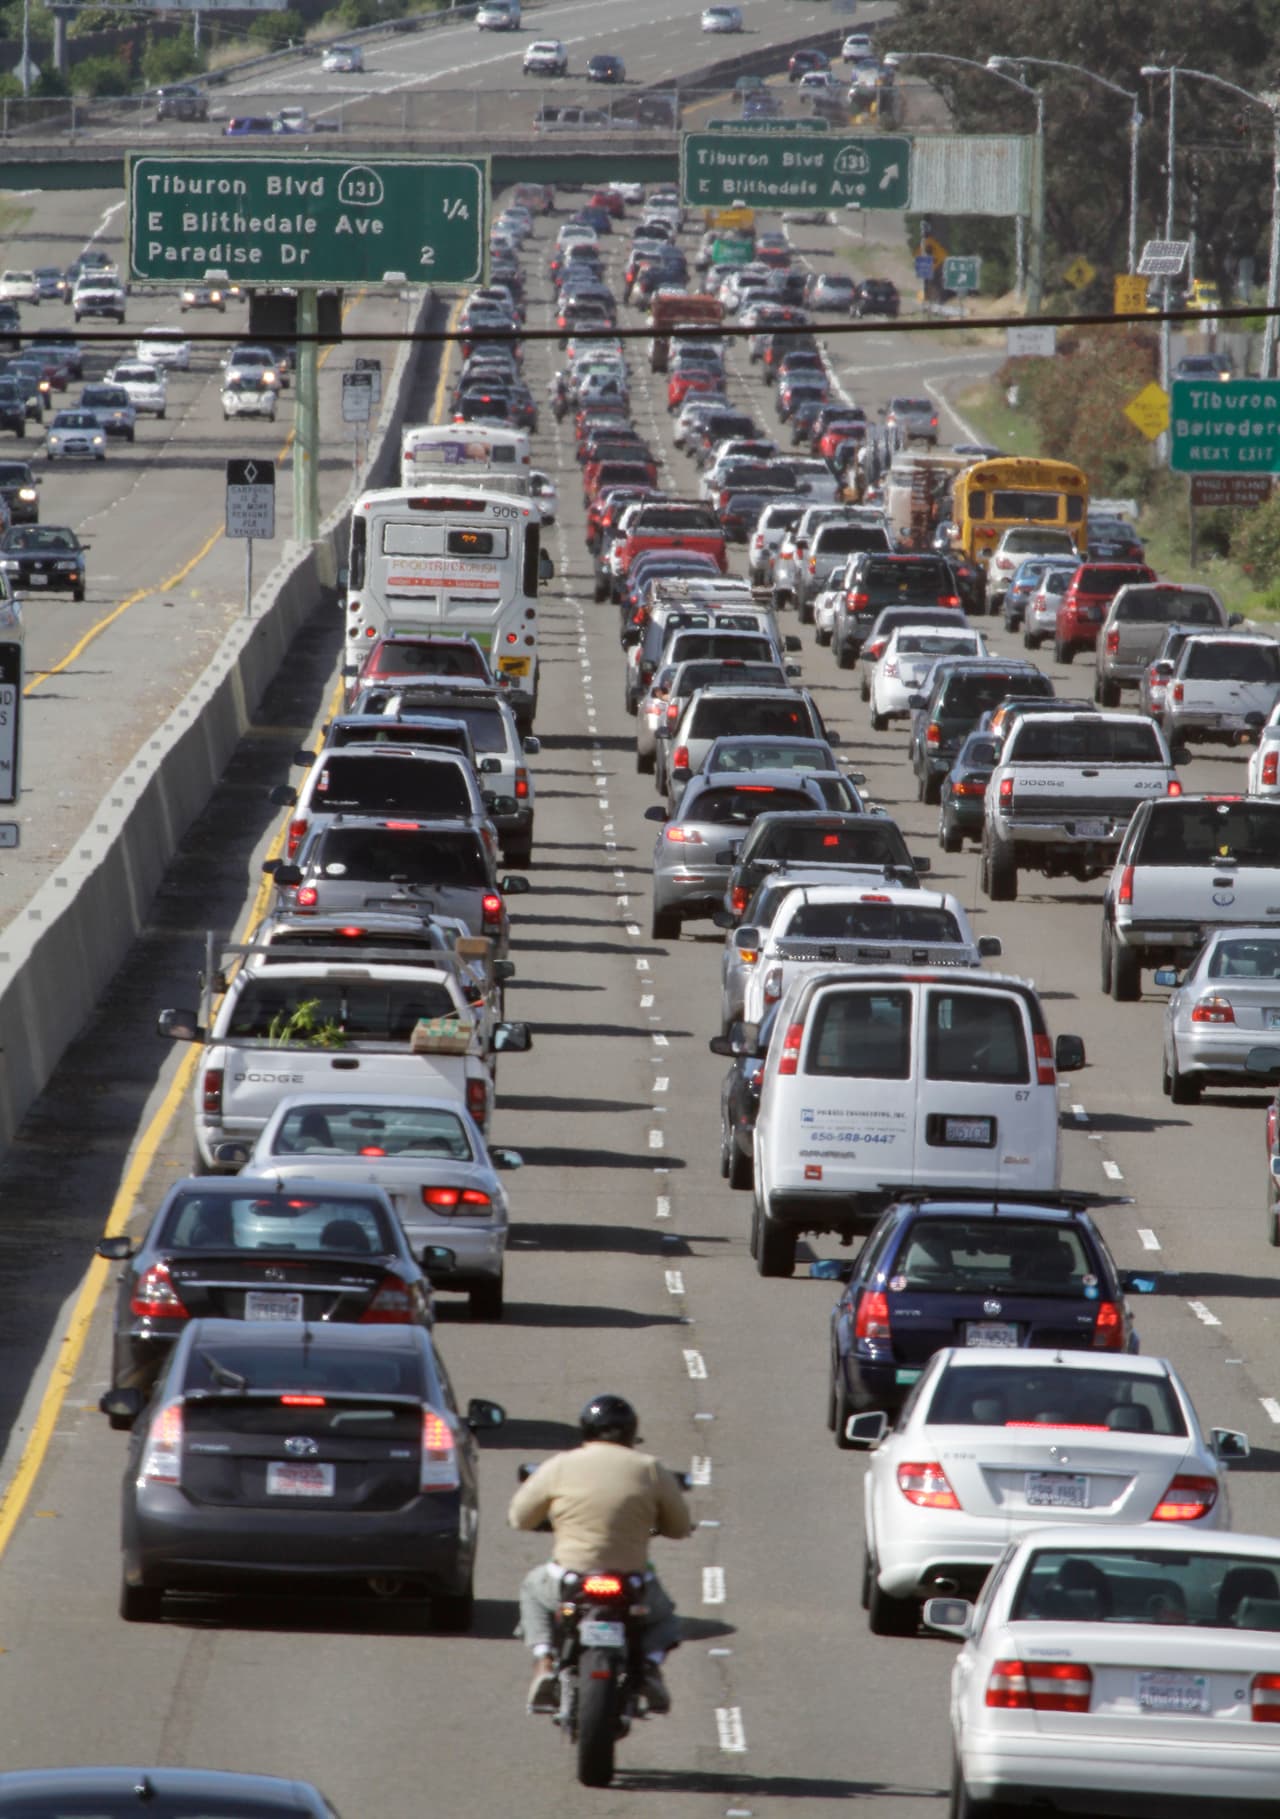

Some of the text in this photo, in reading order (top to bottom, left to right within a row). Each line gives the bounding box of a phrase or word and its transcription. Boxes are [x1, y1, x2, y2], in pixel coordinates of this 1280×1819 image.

[697, 150, 865, 170] Tiburon Blvd 131
[147, 175, 376, 197] Tiburon Blvd 131
[698, 179, 867, 196] E Blithedale Ave
[442, 198, 470, 220] 1/4
[148, 211, 384, 234] E Blithedale Ave
[148, 241, 311, 264] Paradise Dr
[420, 246, 436, 265] 2
[1189, 391, 1277, 409] Tiburon
[1189, 446, 1273, 460] NEXT EXIT
[1019, 780, 1065, 788] DODGE
[234, 1073, 305, 1083] DODGE
[1015, 1090, 1030, 1101] 67
